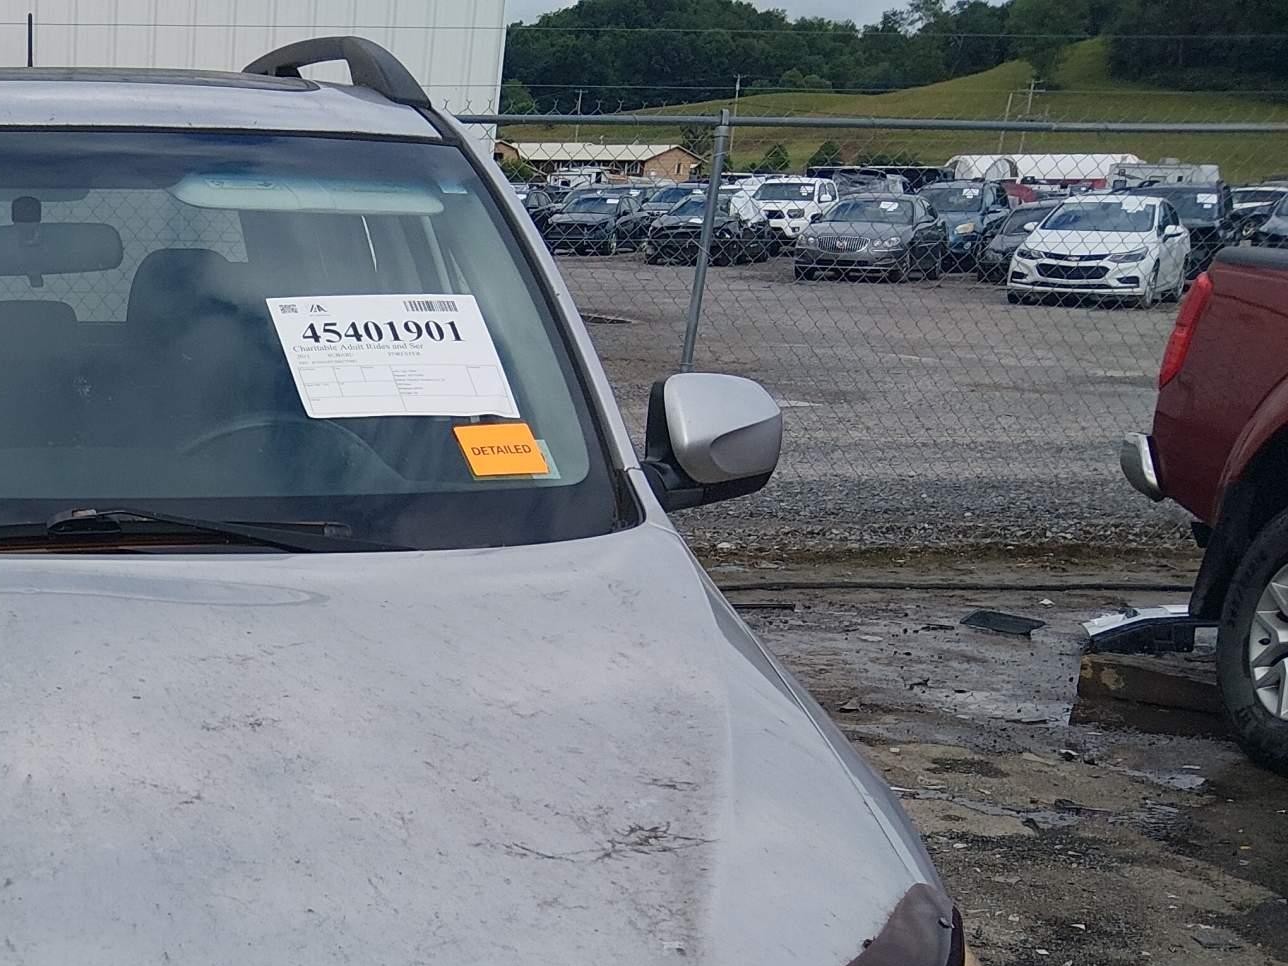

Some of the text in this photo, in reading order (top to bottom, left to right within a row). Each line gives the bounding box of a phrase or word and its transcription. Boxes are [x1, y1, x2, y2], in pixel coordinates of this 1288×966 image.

[302, 320, 465, 344] 45401901
[292, 344, 338, 353] Charitable
[470, 443, 532, 457] DETAILED
